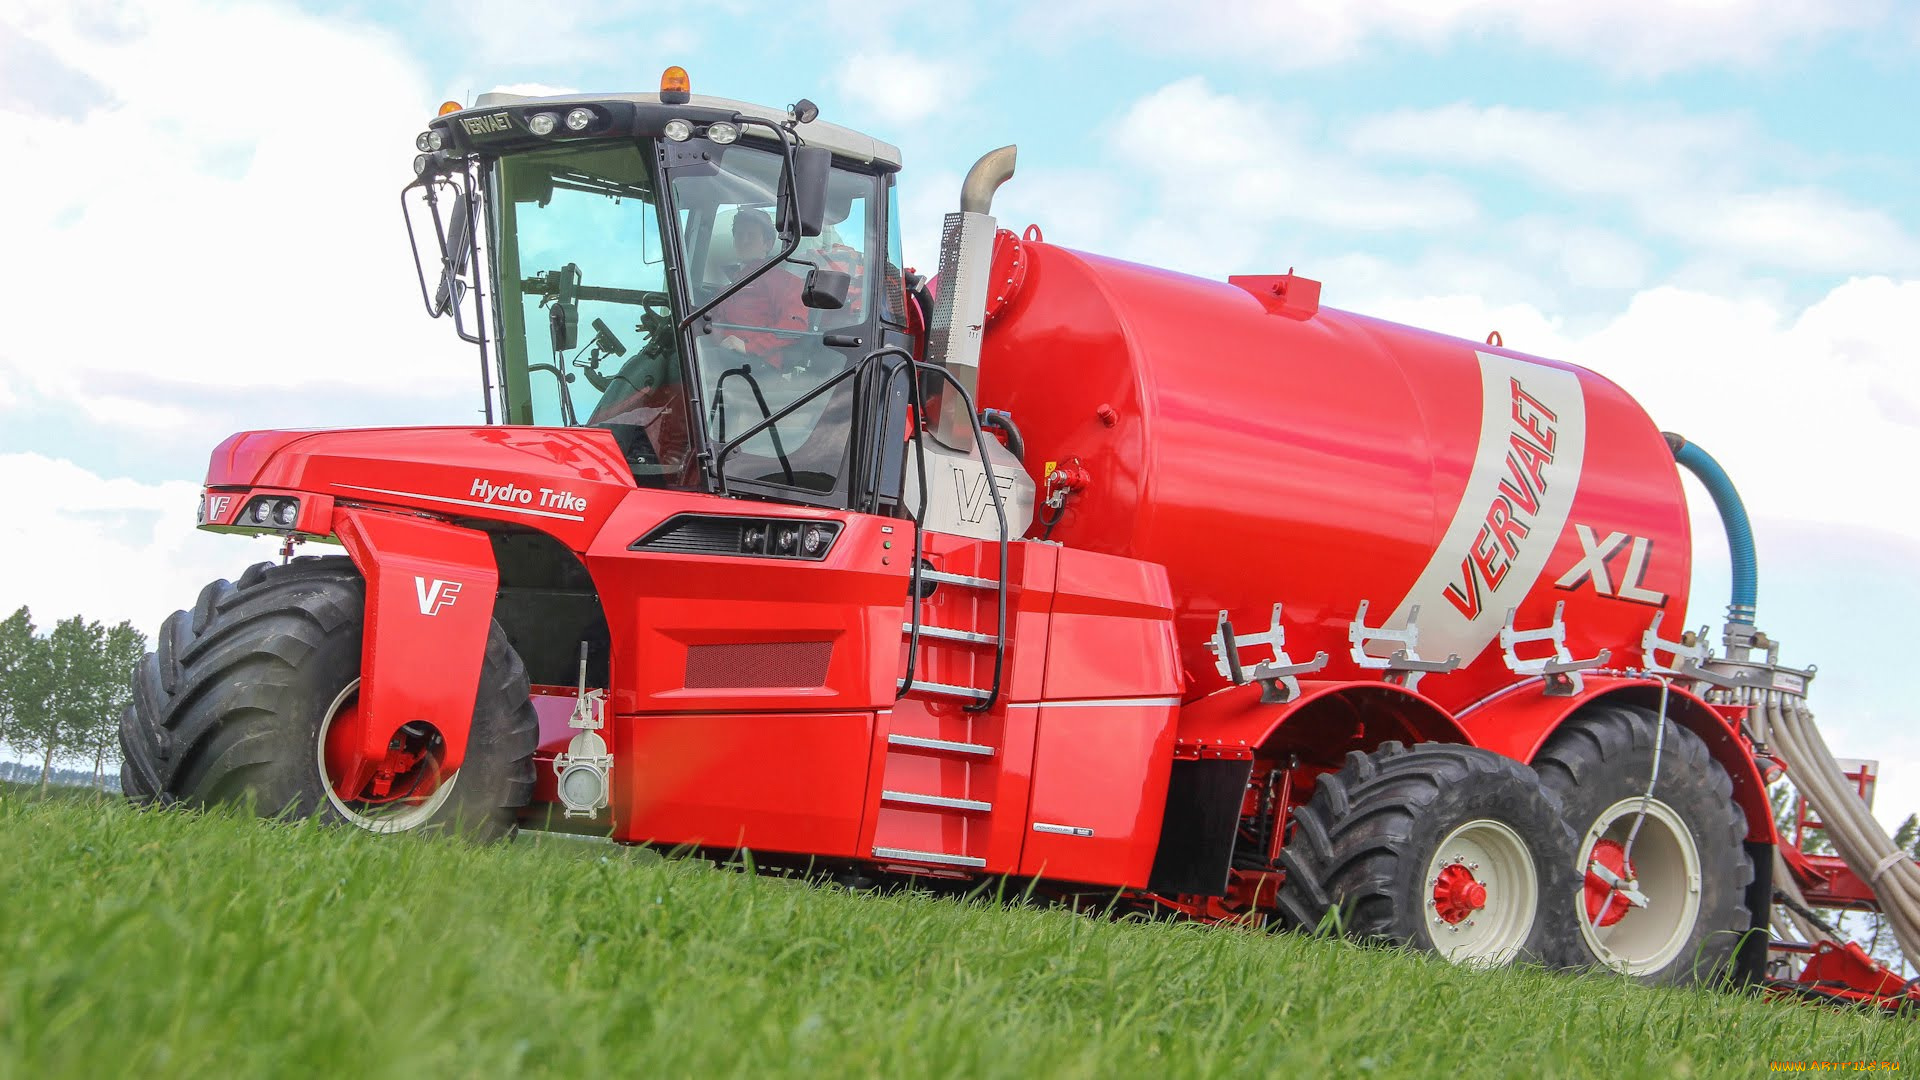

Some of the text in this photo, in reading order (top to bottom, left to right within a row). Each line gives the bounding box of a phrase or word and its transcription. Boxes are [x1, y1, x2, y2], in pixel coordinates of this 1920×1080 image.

[459, 112, 512, 135] VERVAET
[210, 496, 231, 521] VF
[469, 478, 587, 512] Hydro Trike
[953, 468, 1014, 524] VF
[1442, 376, 1558, 621] VERVAET
[1554, 523, 1669, 608] XL
[414, 575, 463, 616] VF
